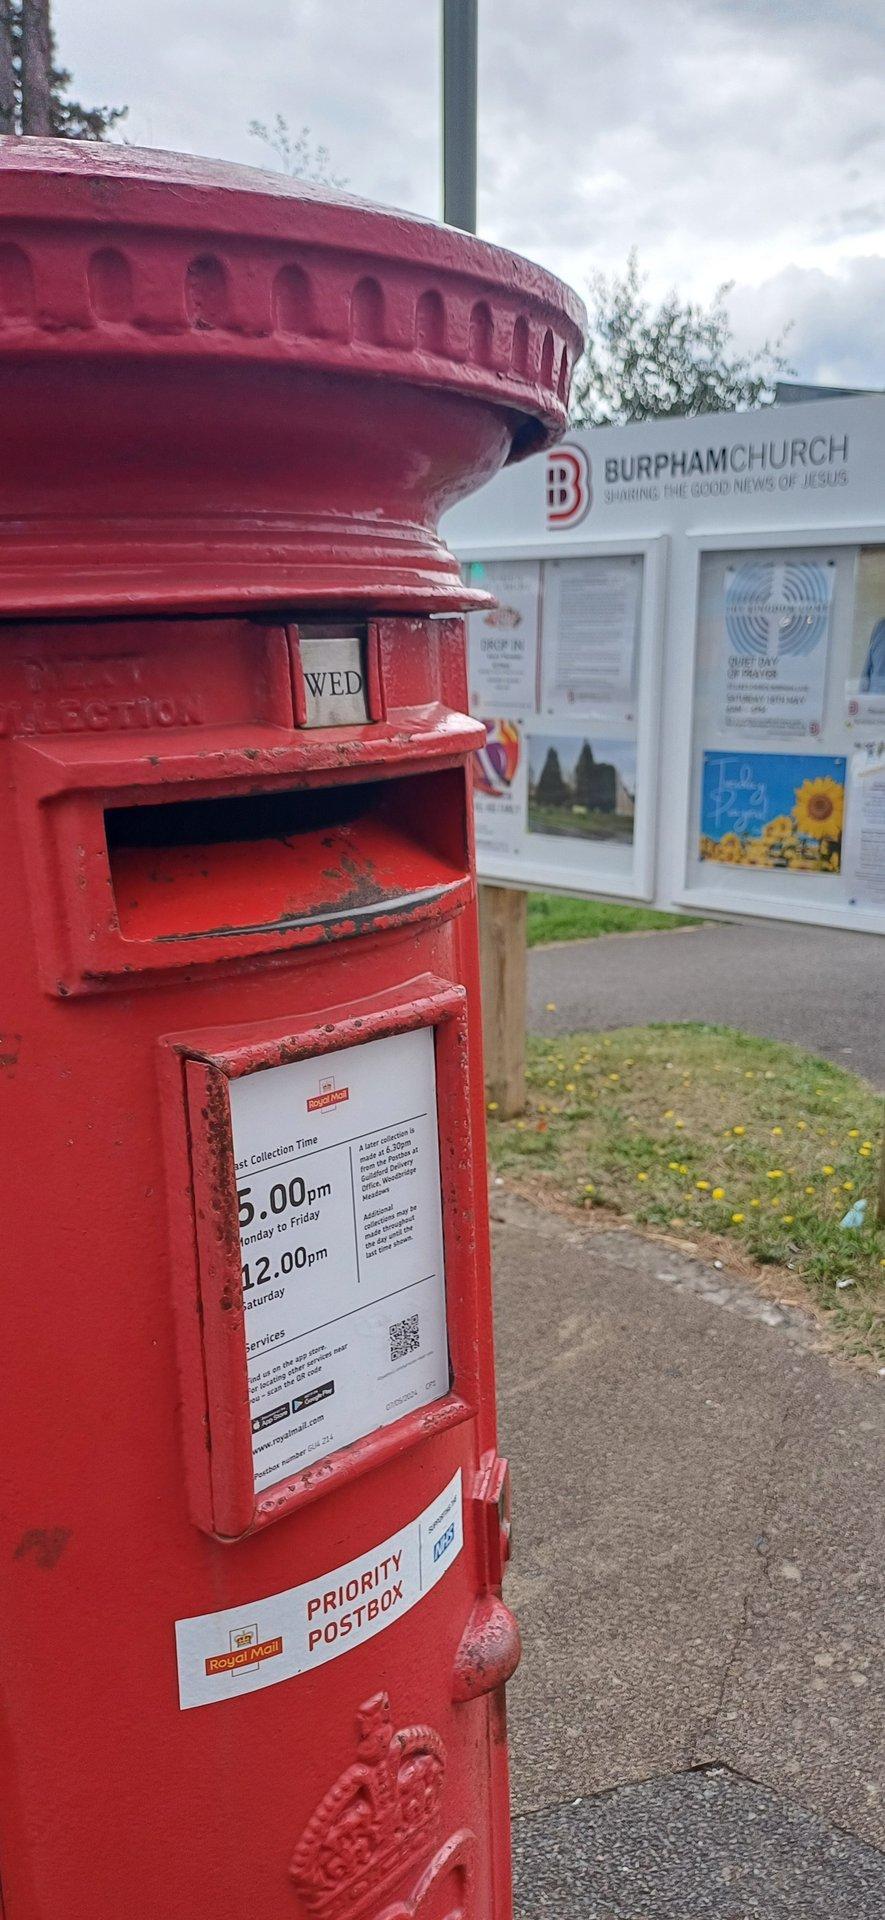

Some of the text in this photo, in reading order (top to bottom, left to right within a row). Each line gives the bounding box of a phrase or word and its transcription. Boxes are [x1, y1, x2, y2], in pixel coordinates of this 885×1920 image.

[604, 434, 848, 482] BURPHAMCHURCH
[604, 468, 849, 504] SHARING THE GOOD NEWS OF JESUS
[303, 671, 362, 697] WED
[0, 695, 204, 735] LLECTION
[309, 1090, 348, 1109] Royal Mail
[234, 1136, 318, 1171] ast Collection Time
[360, 1140, 412, 1163] made at 6.30pm
[365, 1140, 379, 1150] later
[380, 1130, 408, 1145] collection
[360, 1163, 375, 1173] from
[376, 1159, 387, 1167] the
[388, 1150, 411, 1162] Postbox
[361, 1159, 413, 1182] Guildford Delivery
[361, 1167, 416, 1192] Office, Woodbridge
[237, 1177, 331, 1227] 5.00pm
[362, 1187, 390, 1202] Meadows
[277, 1222, 287, 1233] to
[290, 1210, 320, 1228] Friday
[363, 1203, 393, 1221] Additional
[364, 1214, 395, 1230] collections
[396, 1209, 409, 1217] may
[365, 1215, 415, 1240] made throughout
[365, 1225, 413, 1249] the day until the
[366, 1235, 413, 1259] last time shown.
[241, 1246, 328, 1291] 12.00pm
[245, 1329, 286, 1354] Services
[260, 1373, 286, 1391] locating
[288, 1363, 305, 1376] other
[307, 1350, 332, 1367] services
[333, 1343, 348, 1355] near
[263, 1370, 271, 1378] us
[272, 1365, 281, 1373] on
[282, 1359, 293, 1369] the
[295, 1353, 307, 1363] app
[308, 1345, 327, 1357] store.
[250, 1396, 260, 1404] ou
[267, 1385, 283, 1397] scan
[283, 1379, 295, 1388] the
[296, 1372, 306, 1382] QR
[307, 1366, 322, 1377] code
[252, 1415, 324, 1455] www.royalmail.com
[254, 1464, 280, 1480] Postbox
[281, 1449, 306, 1466] number
[434, 1525, 454, 1561] NHS
[307, 1549, 402, 1621] PRIORITY
[308, 1580, 403, 1651] POSTBOX
[209, 1641, 279, 1671] Royal Mail
